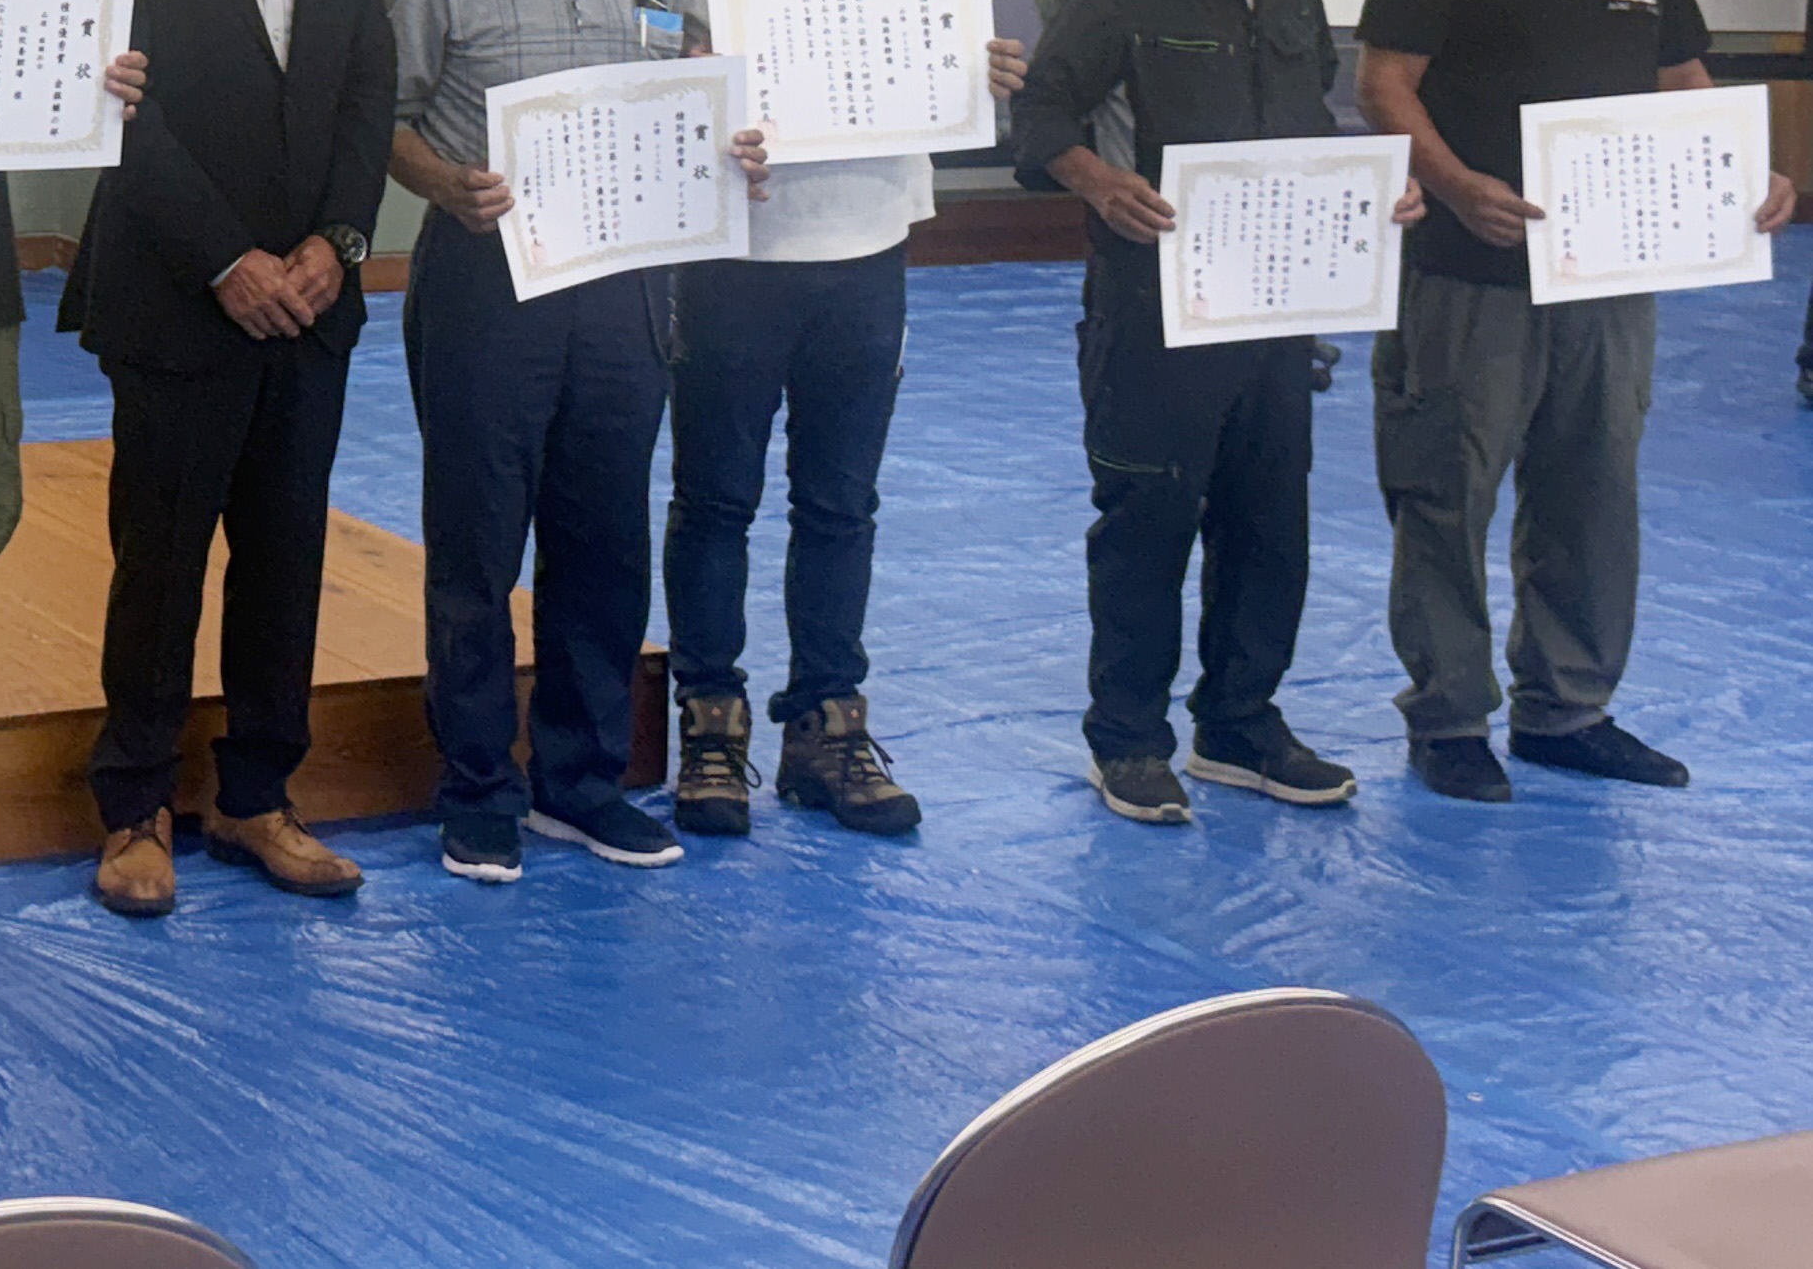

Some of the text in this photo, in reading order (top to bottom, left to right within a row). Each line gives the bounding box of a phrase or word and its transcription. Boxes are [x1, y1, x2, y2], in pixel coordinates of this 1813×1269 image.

[75, 18, 95, 79] 賞状
[939, 12, 959, 69] 賞状
[692, 124, 711, 180] 賞状
